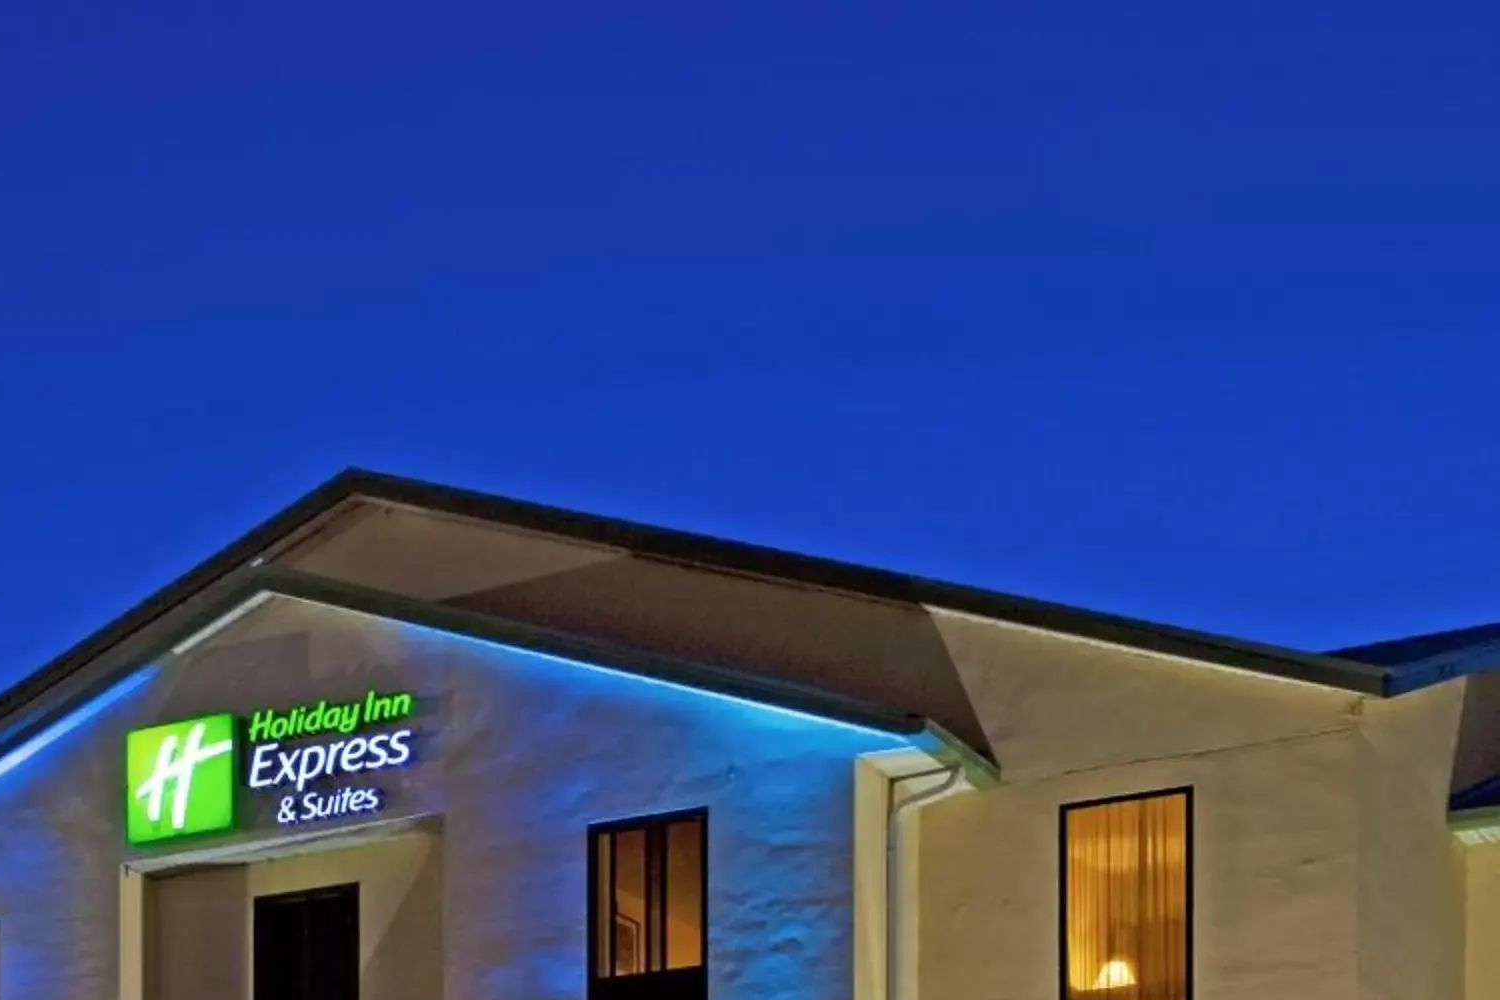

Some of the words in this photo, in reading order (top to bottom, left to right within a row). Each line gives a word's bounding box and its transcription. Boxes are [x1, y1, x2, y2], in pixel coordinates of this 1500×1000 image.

[249, 701, 360, 742] Holiday
[364, 690, 411, 723] Inn
[249, 730, 411, 791] Express
[277, 795, 296, 824] &
[300, 788, 379, 819] Suites
